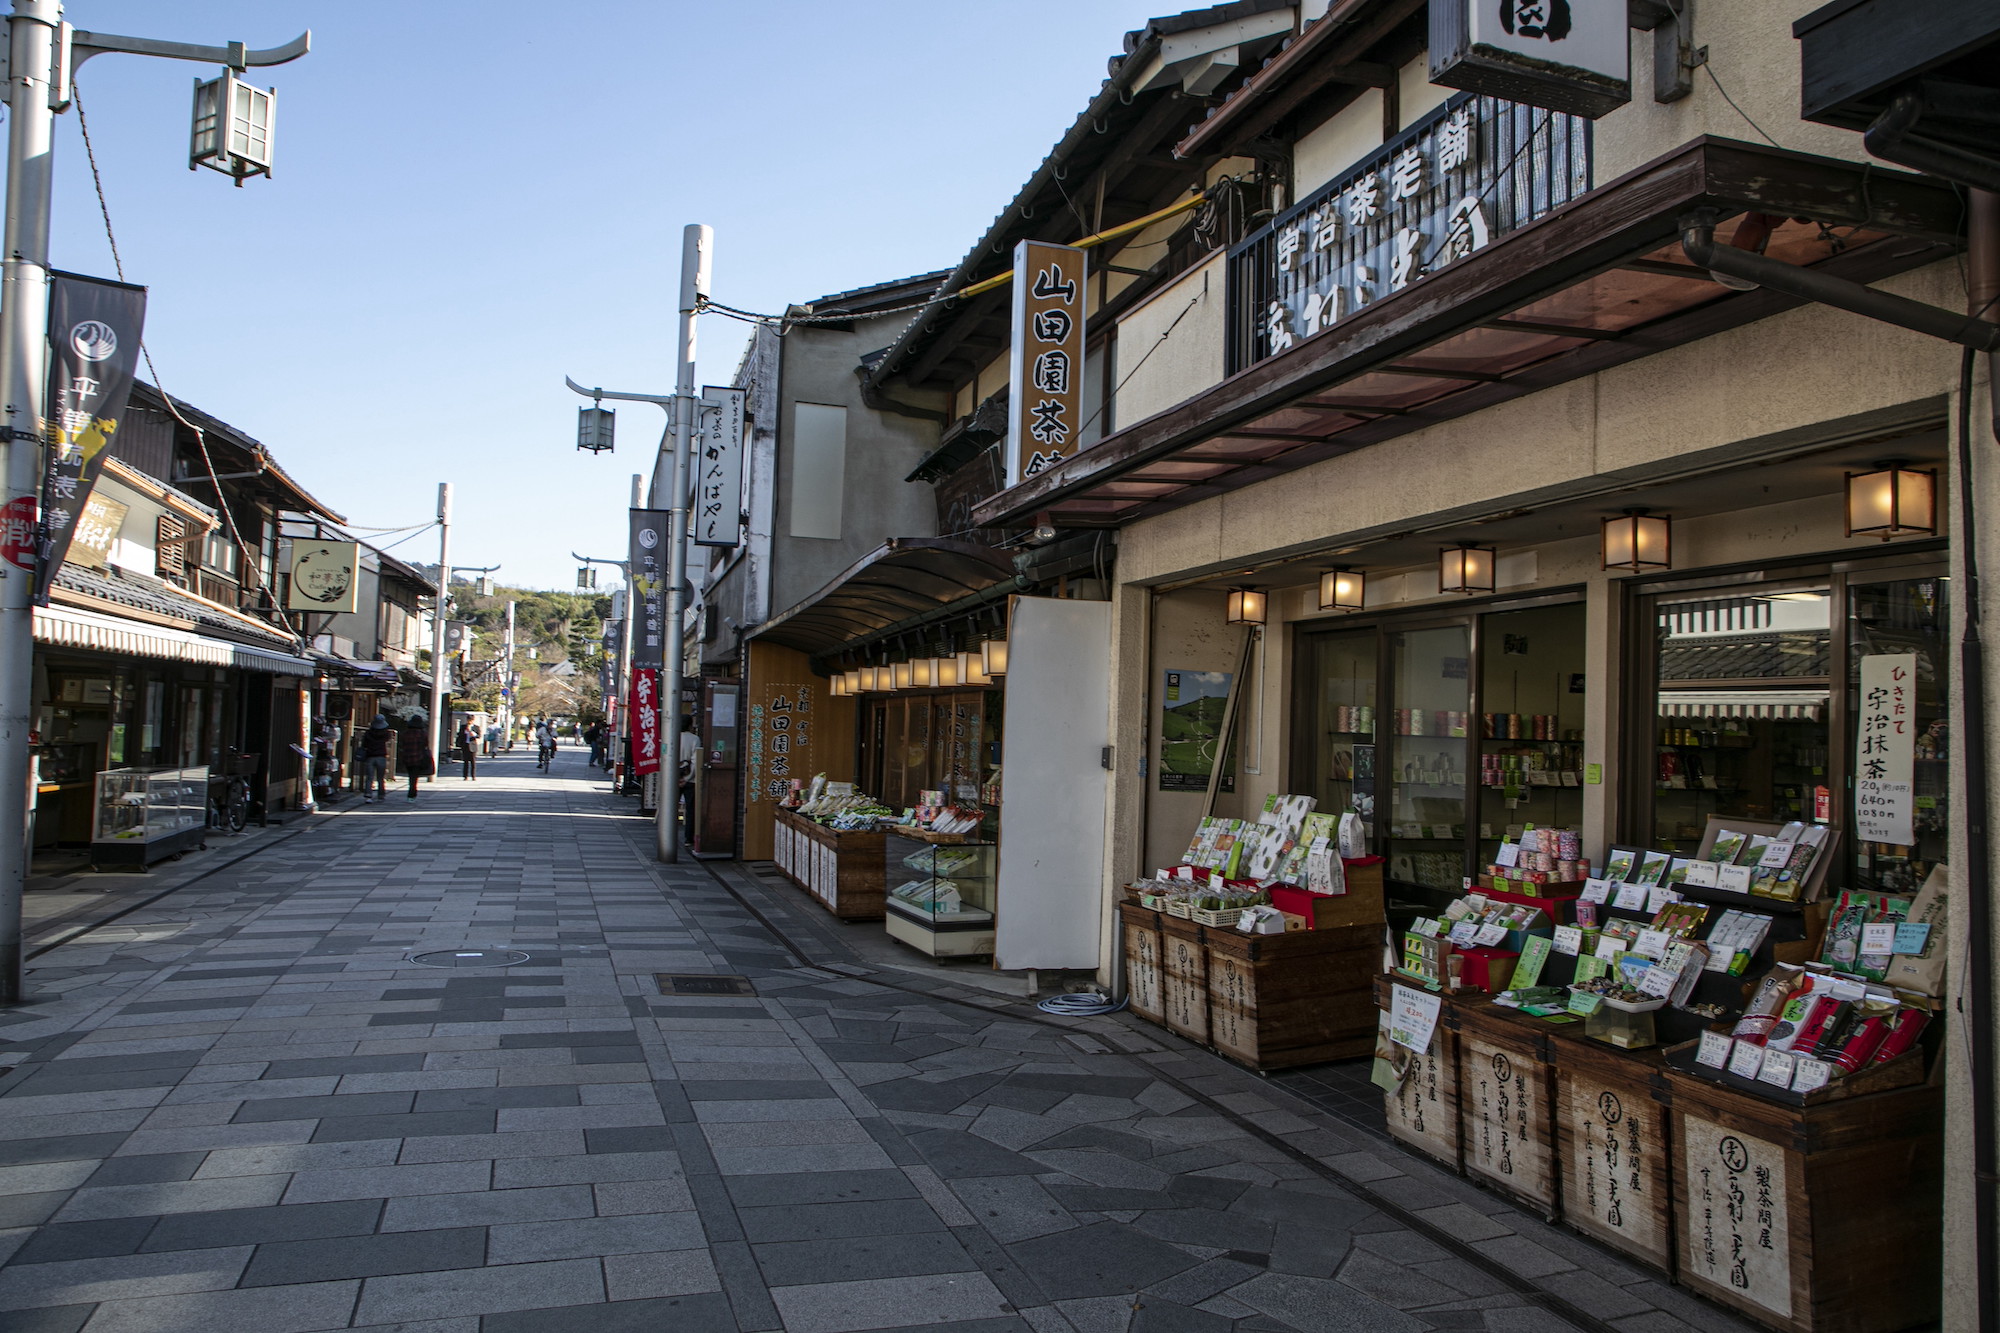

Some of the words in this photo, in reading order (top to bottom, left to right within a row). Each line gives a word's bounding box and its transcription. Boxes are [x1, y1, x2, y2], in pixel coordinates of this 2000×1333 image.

[1277, 110, 1473, 273] 宇治茶老舗
[637, 672, 656, 758] 宇治茶
[796, 687, 810, 714] 京都
[796, 720, 809, 747] 宇治
[1862, 687, 1890, 780] 宇治抹茶
[1891, 666, 1907, 735] ひきたて
[768, 694, 794, 798] 山田園茶舗
[1857, 808, 1896, 819] 1080円
[1860, 794, 1896, 805] 640円
[1625, 1116, 1643, 1192] 製茶問屋
[1753, 1164, 1774, 1251] 製茶問屋
